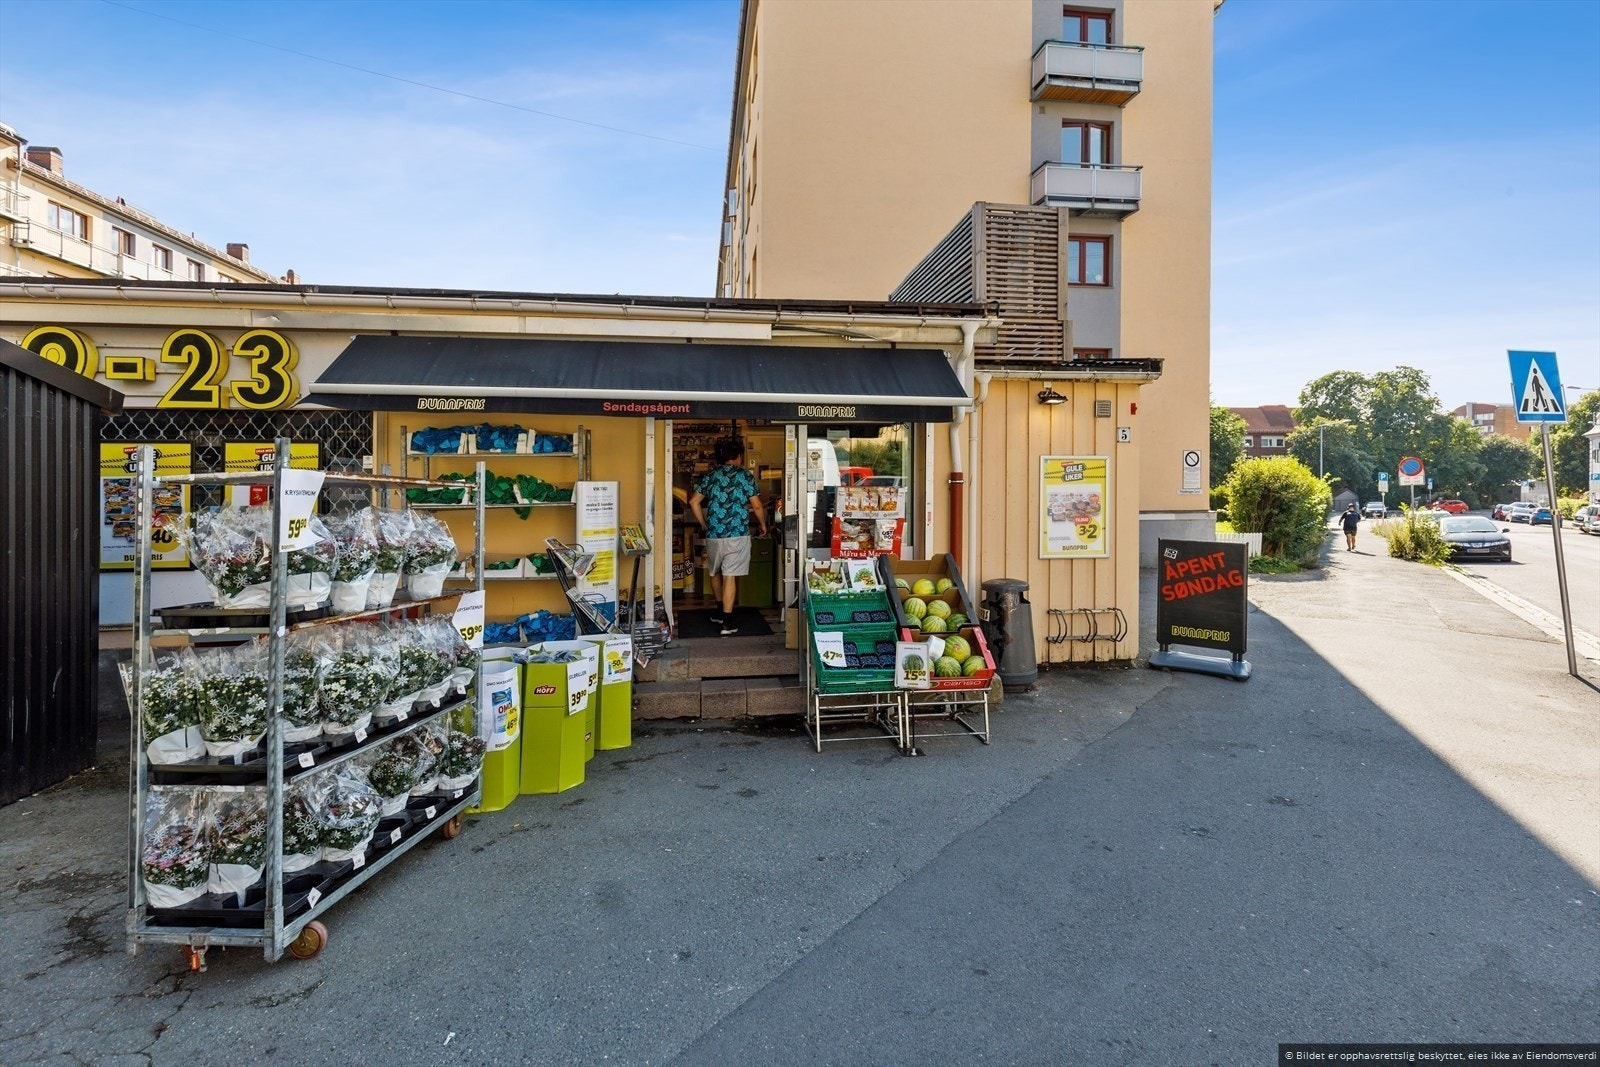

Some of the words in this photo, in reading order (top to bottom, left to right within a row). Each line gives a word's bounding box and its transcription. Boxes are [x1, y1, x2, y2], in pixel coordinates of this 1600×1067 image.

[417, 398, 486, 410] BUNNPRIS
[603, 402, 690, 414] Søndagsåpent
[798, 405, 856, 418] BUNNPRIS
[1121, 429, 1129, 441] 5
[1065, 465, 1083, 473] GULE
[1164, 552, 1225, 581] ÅPENT
[1161, 569, 1244, 602] SØNDAG
[1171, 625, 1231, 642] BUNNPRIS
